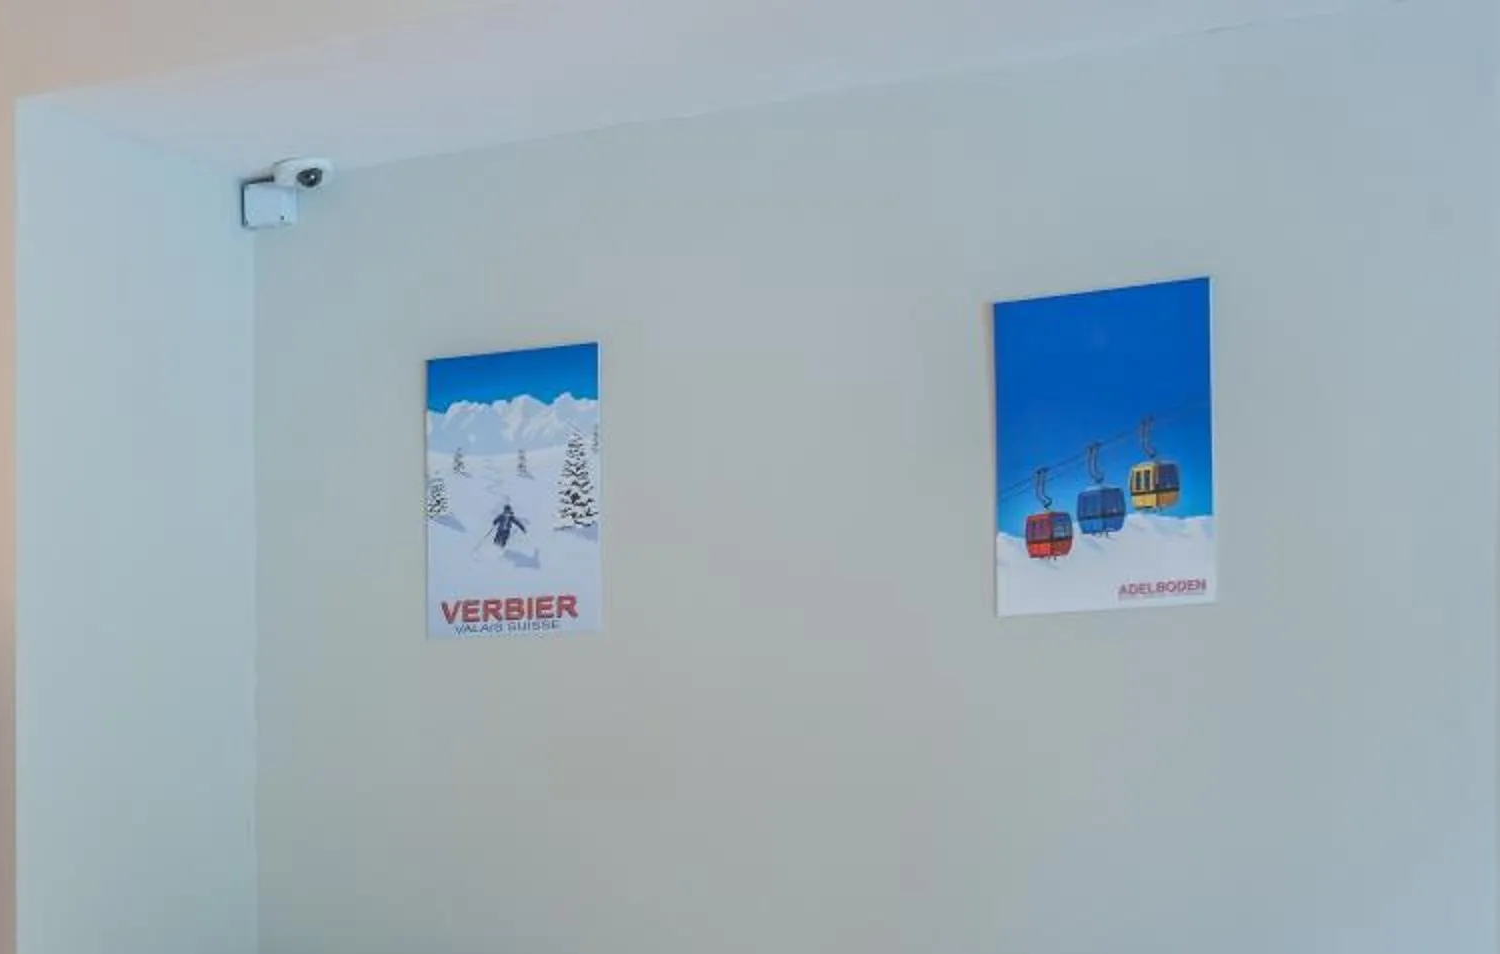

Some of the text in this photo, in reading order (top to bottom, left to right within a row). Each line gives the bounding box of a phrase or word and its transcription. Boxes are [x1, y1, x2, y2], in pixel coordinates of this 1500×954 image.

[1118, 579, 1207, 595] ADELBODEN
[440, 595, 579, 624] VERBIER
[454, 623, 503, 635] VALAIS
